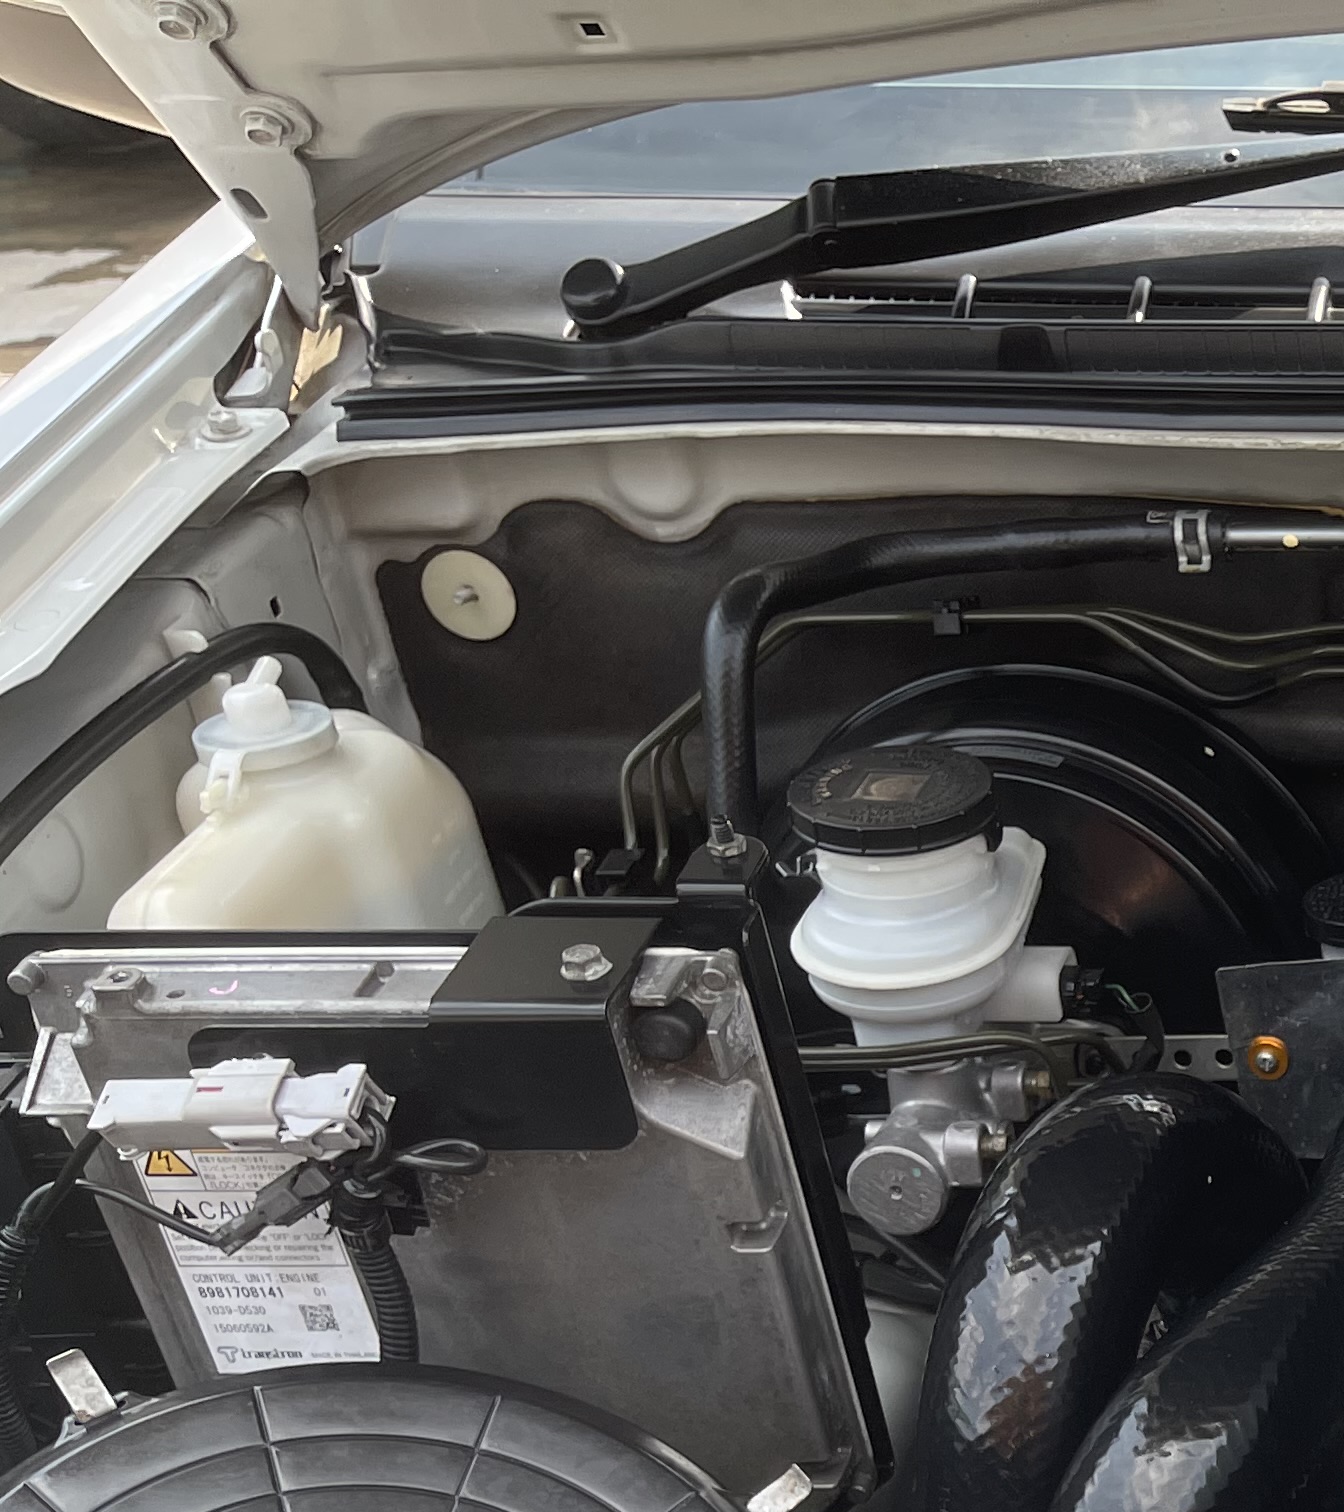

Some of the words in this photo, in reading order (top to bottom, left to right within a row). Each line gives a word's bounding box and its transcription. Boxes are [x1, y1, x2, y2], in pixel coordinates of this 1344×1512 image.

[192, 1273, 241, 1284] CONTROL
[198, 1286, 284, 1298] 8981708141
[313, 1286, 327, 1297] 01
